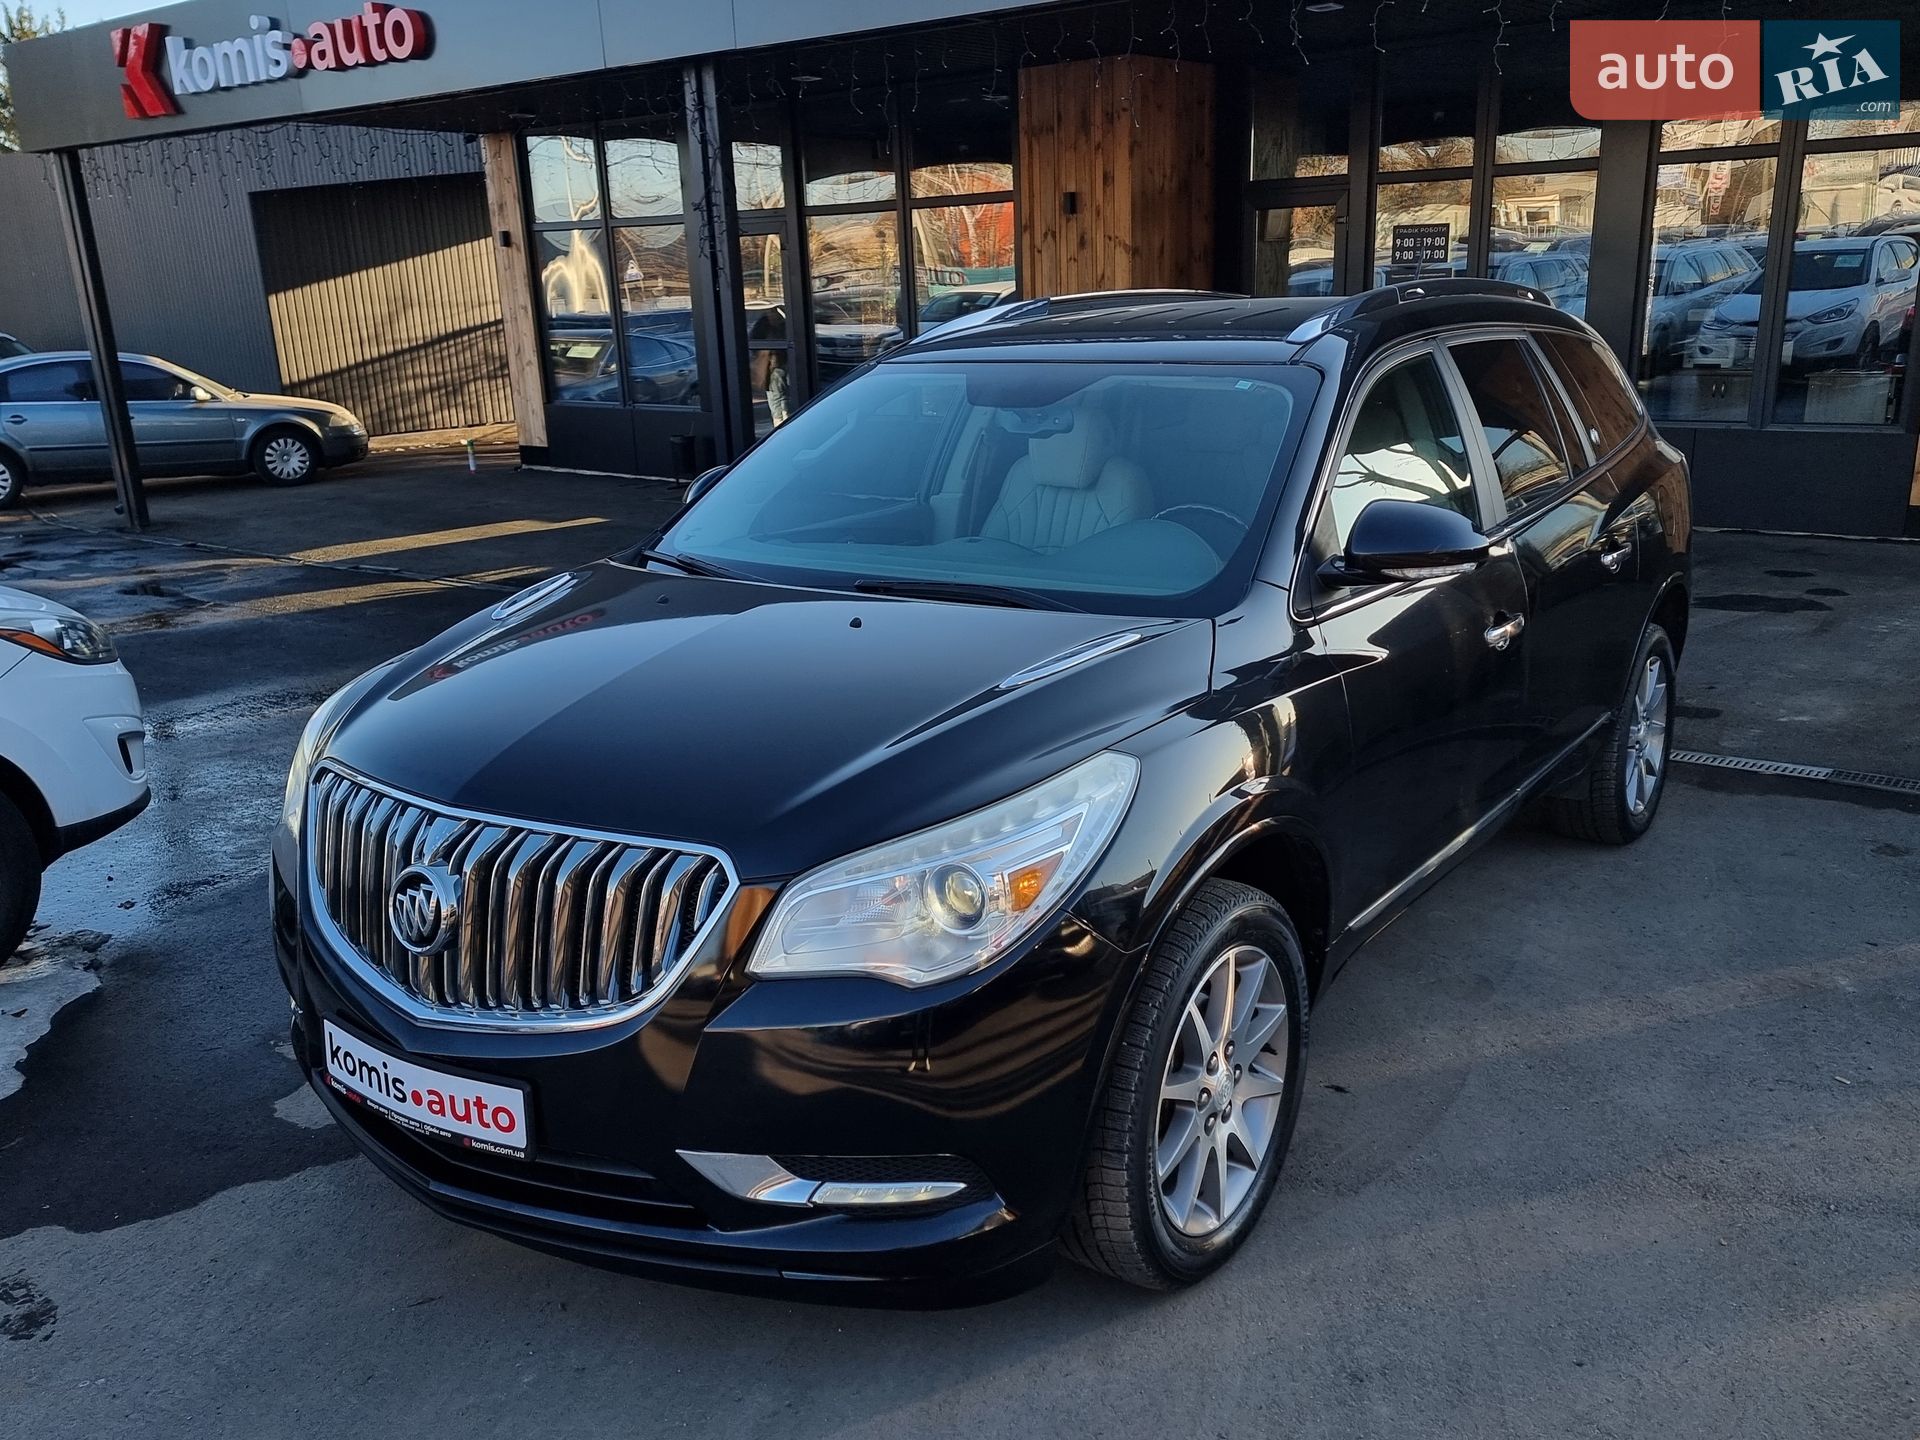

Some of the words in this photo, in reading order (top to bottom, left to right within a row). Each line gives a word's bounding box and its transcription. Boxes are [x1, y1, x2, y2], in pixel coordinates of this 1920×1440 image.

[1395, 237, 1414, 247] 9:00
[1423, 236, 1446, 247] 19:00
[1395, 250, 1414, 260] 9:00
[1423, 249, 1445, 260] 17:00
[471, 1139, 525, 1159] komis.com.ua
